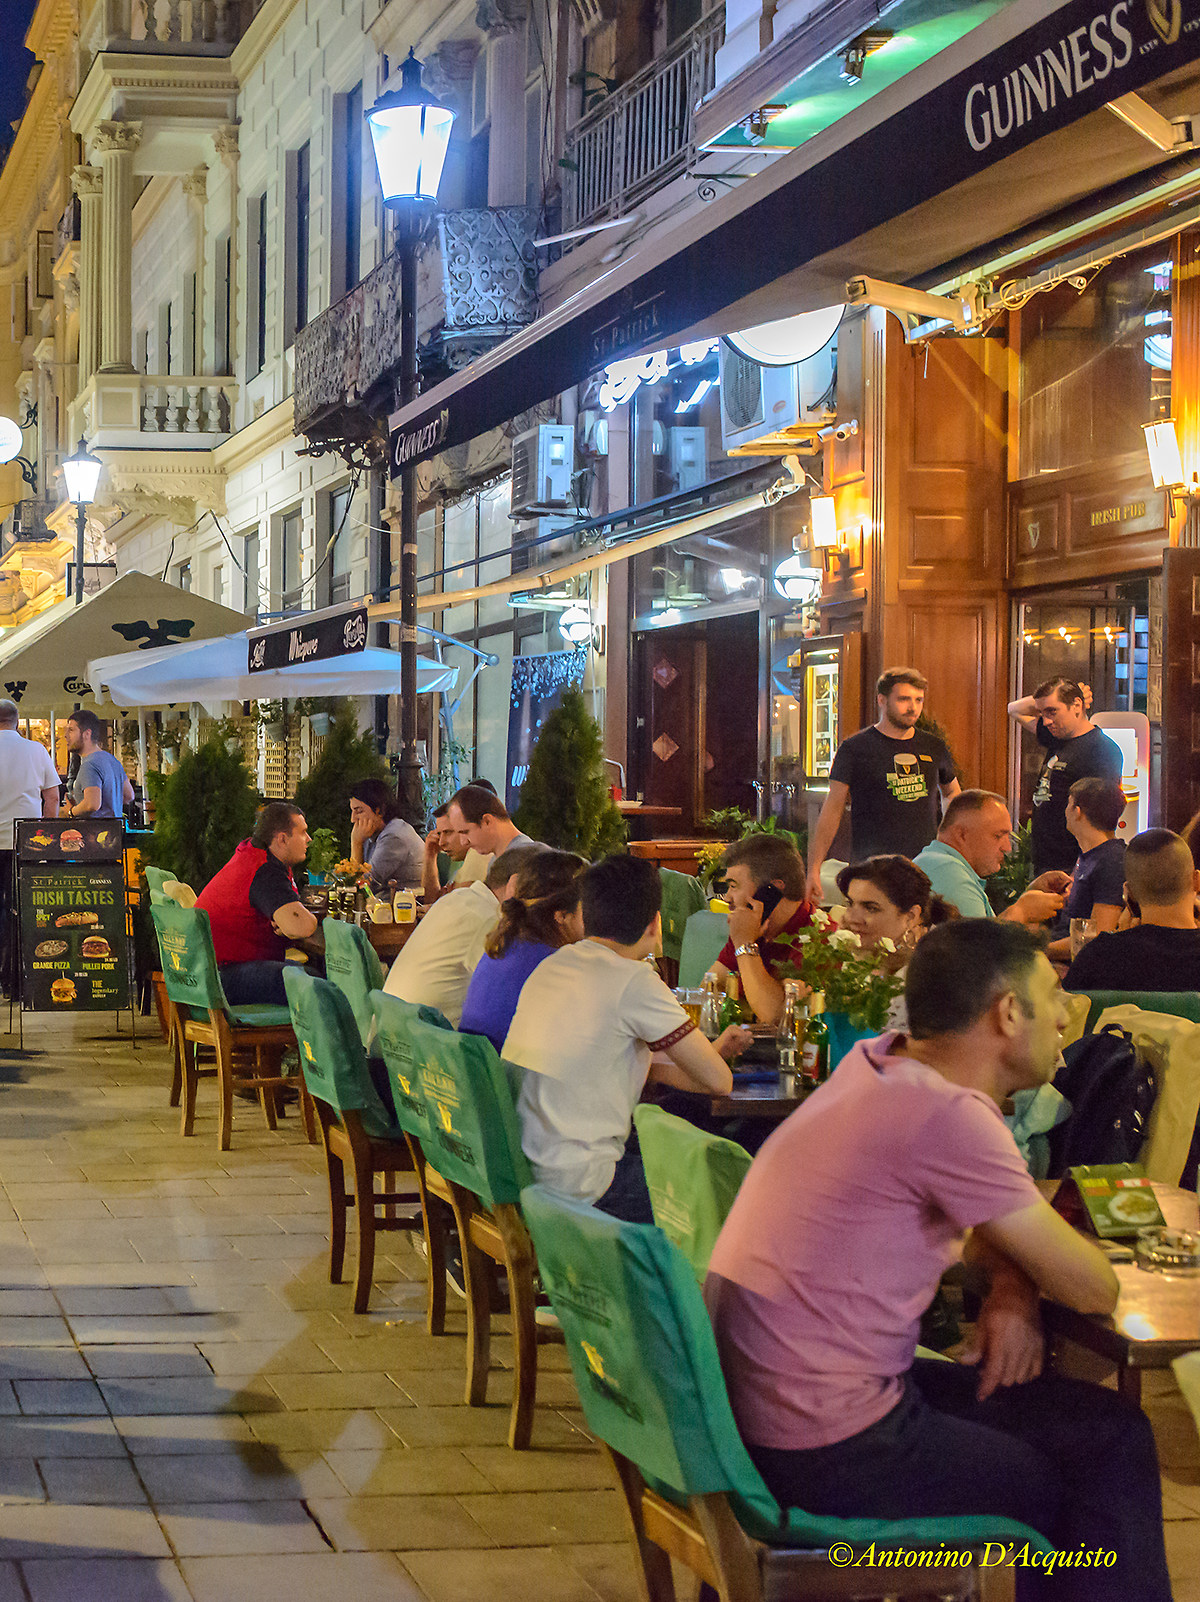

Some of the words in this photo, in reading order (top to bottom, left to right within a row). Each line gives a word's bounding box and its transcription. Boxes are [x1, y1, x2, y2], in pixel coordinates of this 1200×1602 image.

[964, 1, 1132, 151] GUINNESS
[612, 305, 660, 347] Patrick
[395, 418, 440, 466] GUINNESS
[1091, 508, 1121, 526] IRISH
[1123, 502, 1146, 519] PUB
[895, 783, 923, 795] WEEKEND
[32, 891, 64, 906] IRISH
[67, 891, 115, 905] TASTES
[32, 961, 53, 970] GRANDE
[54, 961, 71, 970] PIZZA
[82, 962, 101, 970] PULLED
[101, 962, 115, 970] PORK
[92, 980, 103, 988] THE
